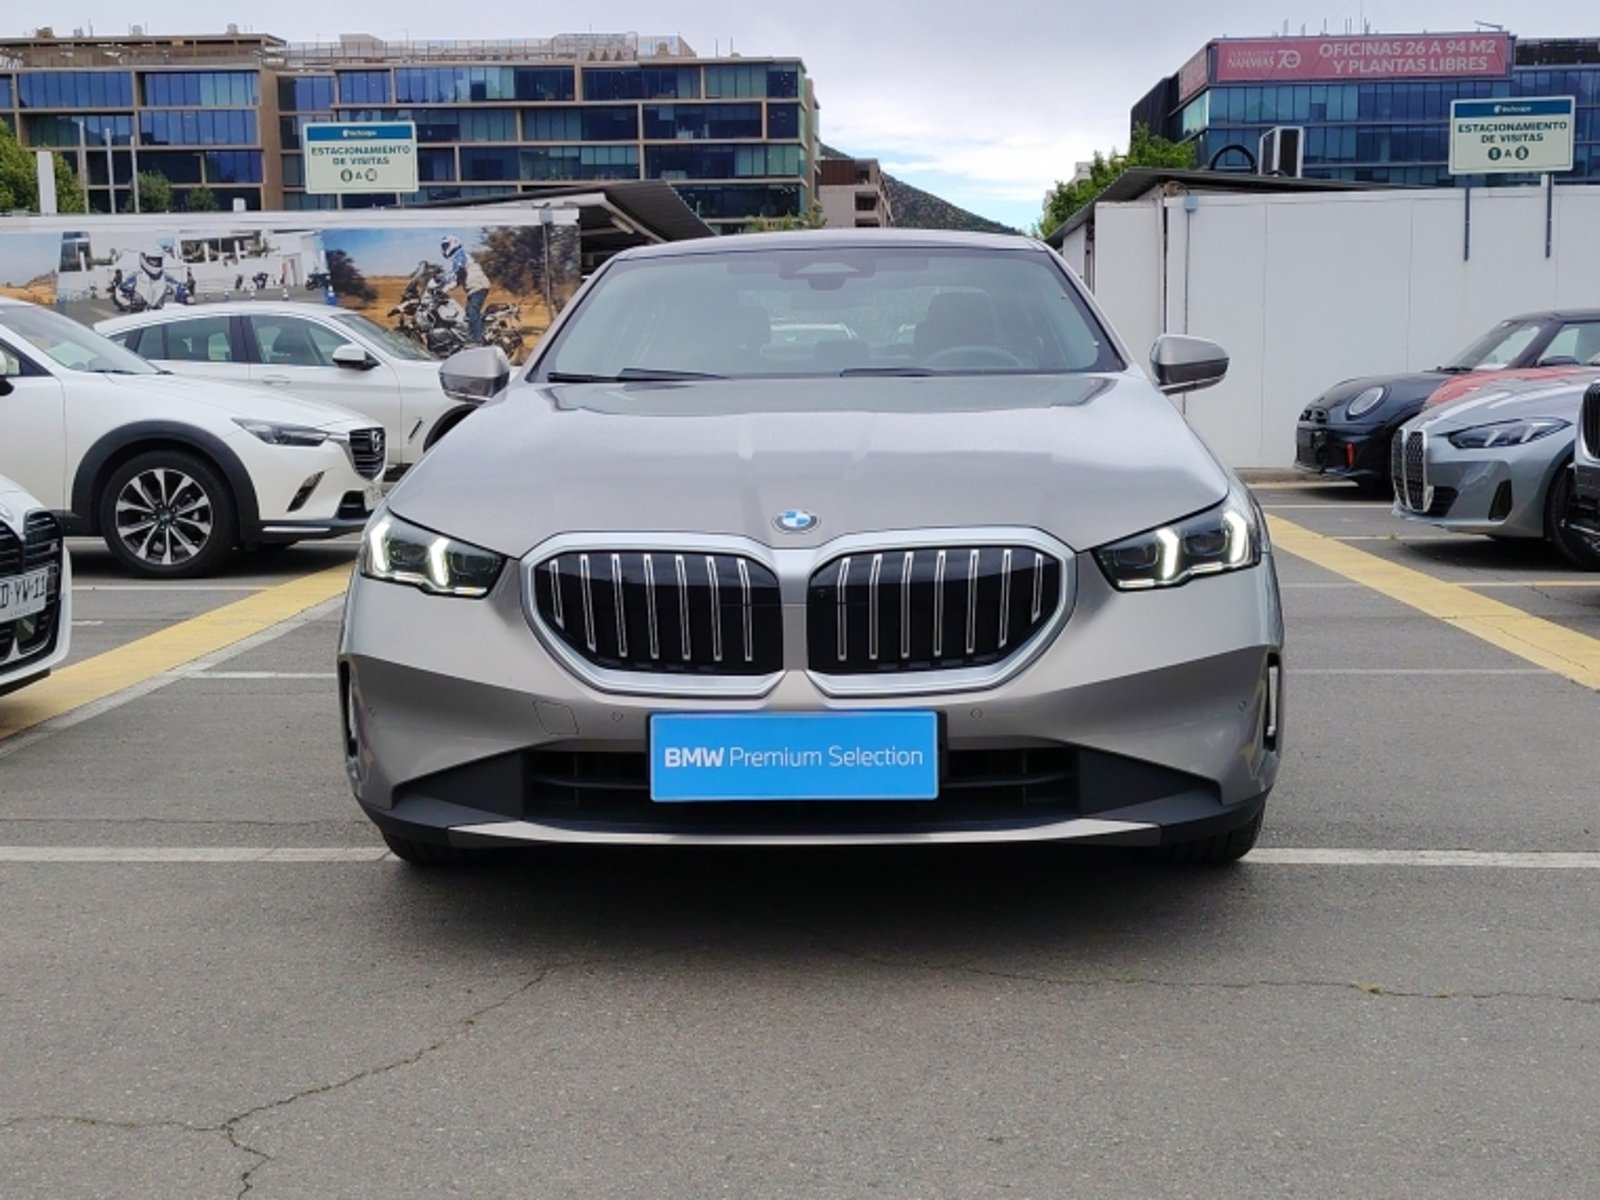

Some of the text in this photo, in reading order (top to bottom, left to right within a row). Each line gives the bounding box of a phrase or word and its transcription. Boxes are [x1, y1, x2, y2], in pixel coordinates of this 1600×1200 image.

[1319, 39, 1496, 57] OFICINAS 26 A 94 M2
[1333, 56, 1488, 74] Y PLANTAS LIBRES
[1457, 121, 1568, 133] ESTACIONAMIENTO
[1481, 132, 1544, 144] DE VISITAS
[311, 145, 411, 155] ESTACIONAMIENTO
[332, 156, 390, 165] DE VISITAS
[664, 744, 924, 768] BMW Premium Selection
